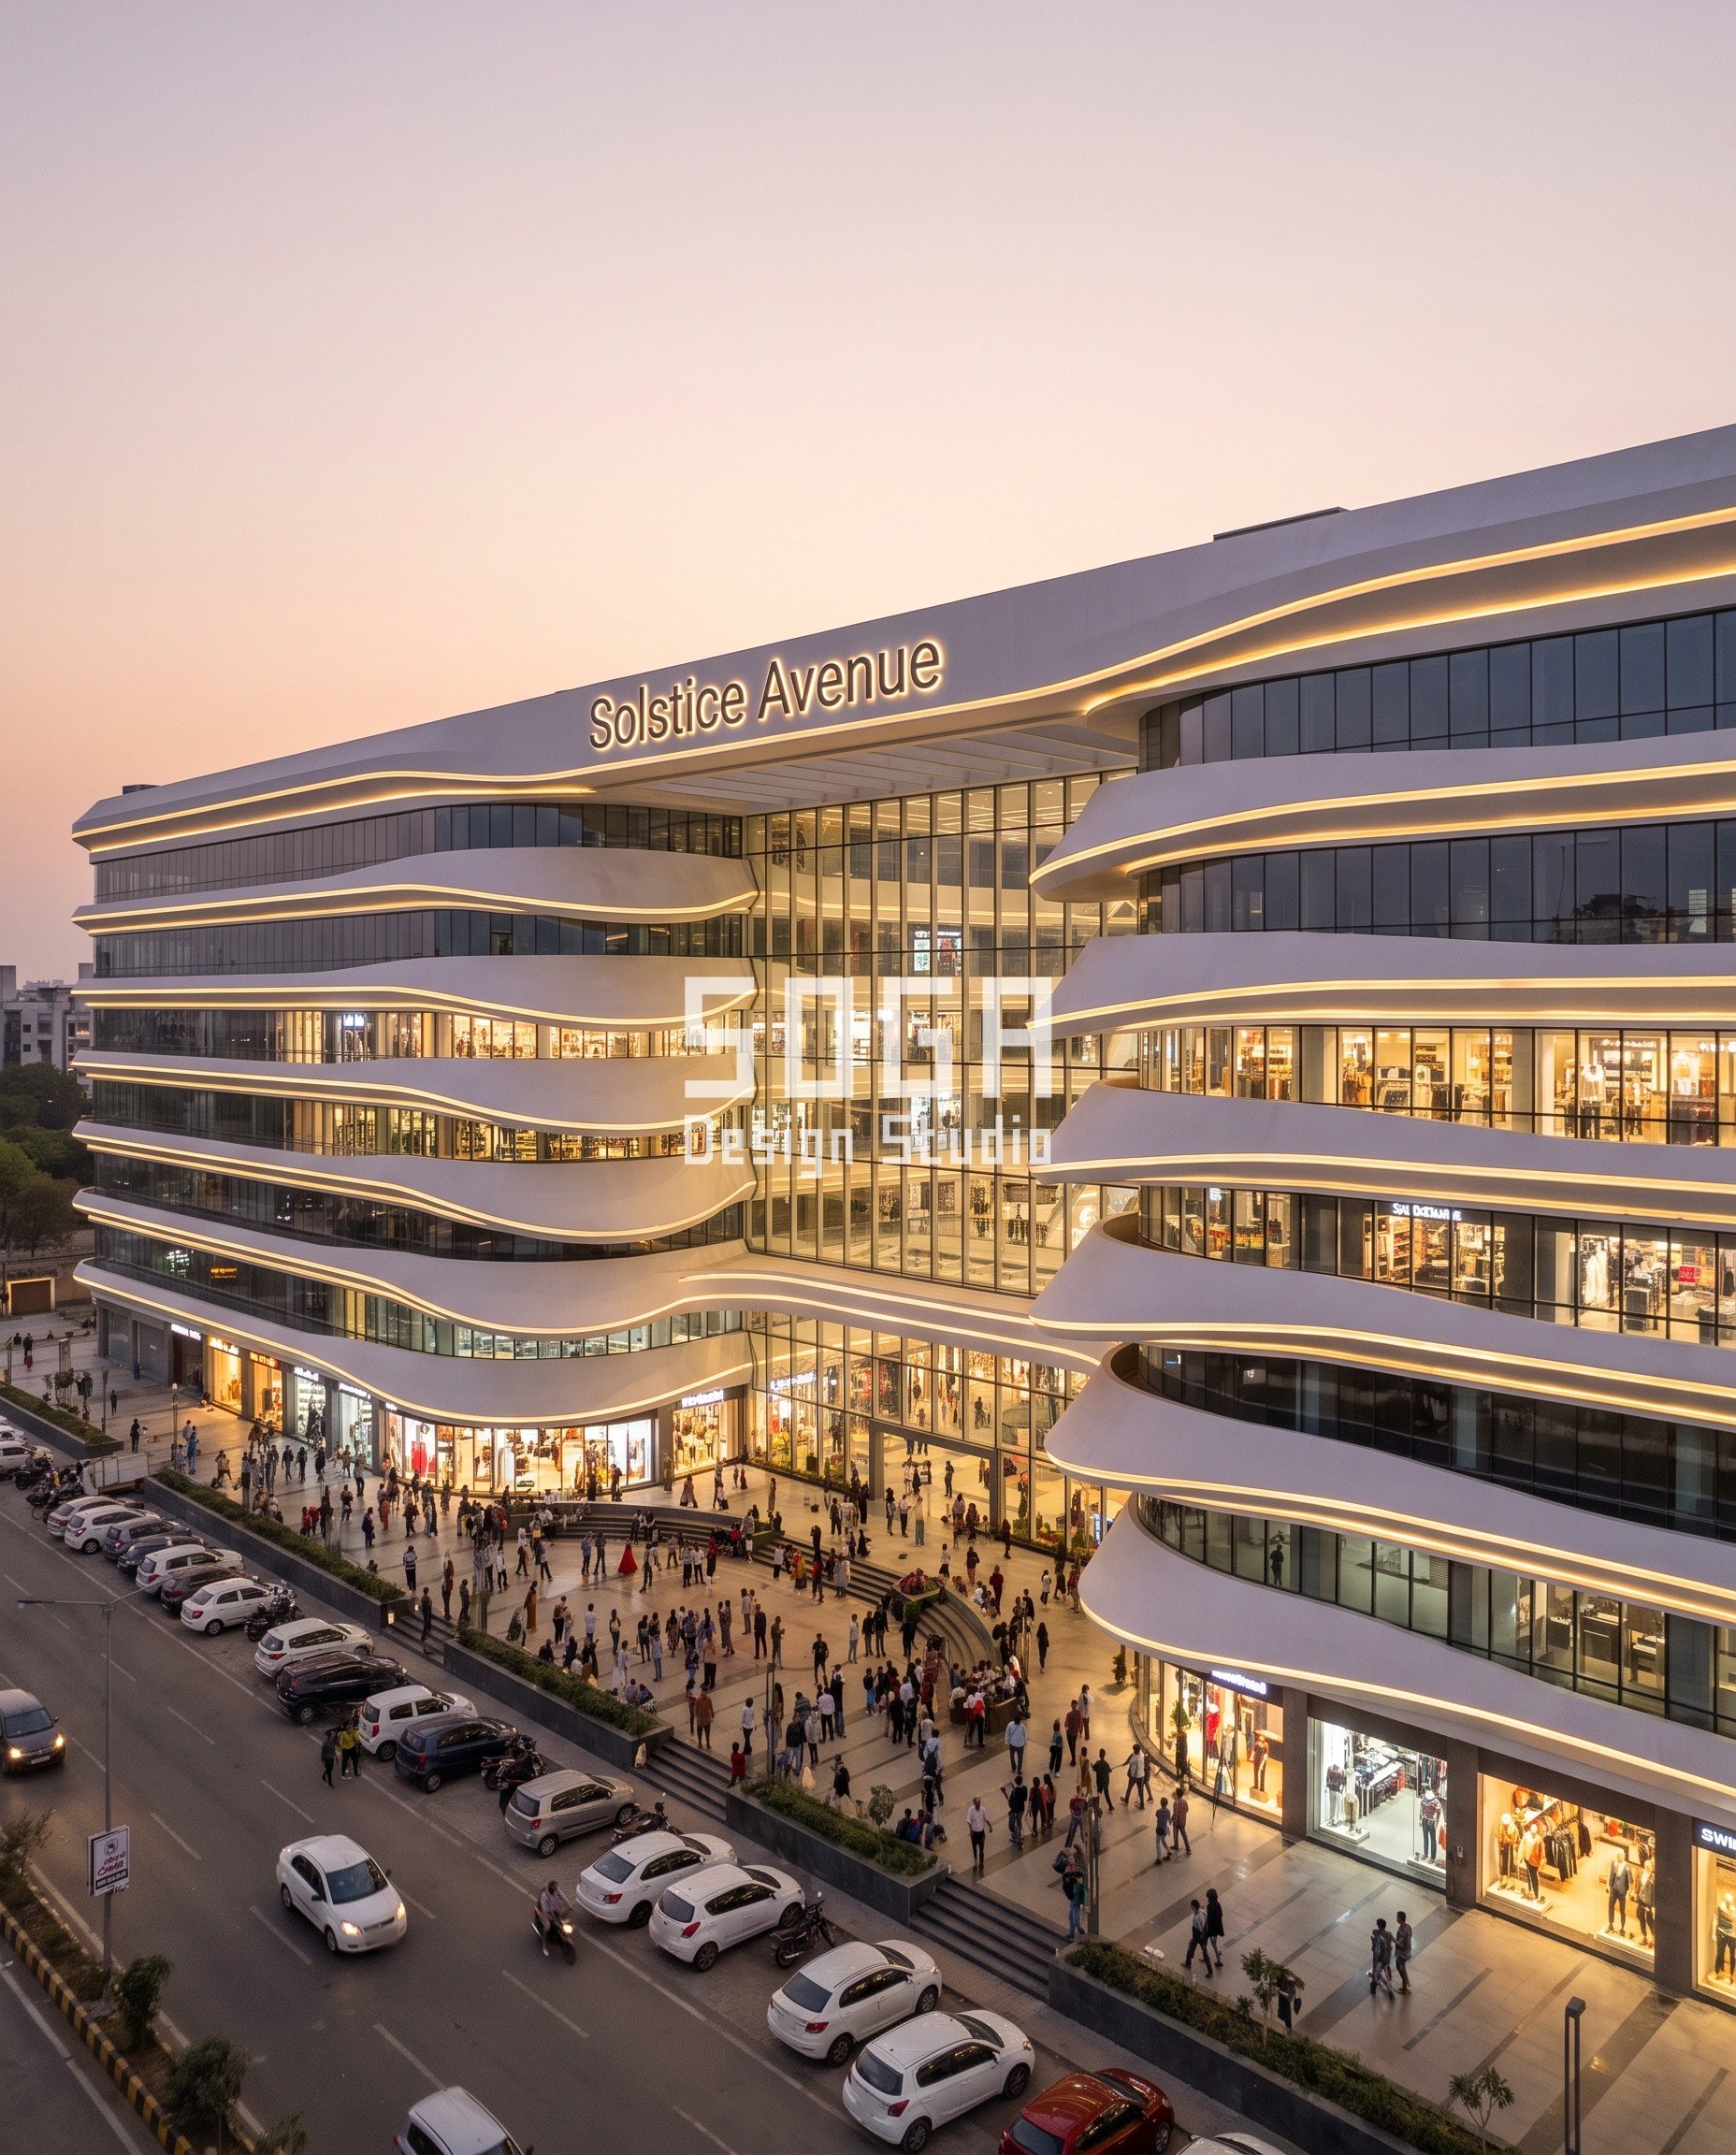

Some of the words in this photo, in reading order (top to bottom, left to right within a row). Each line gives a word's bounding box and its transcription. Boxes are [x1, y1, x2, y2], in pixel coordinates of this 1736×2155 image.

[589, 677, 745, 749] Solstice
[758, 642, 940, 719] Avenue
[1700, 1828, 1736, 1851] SWI
